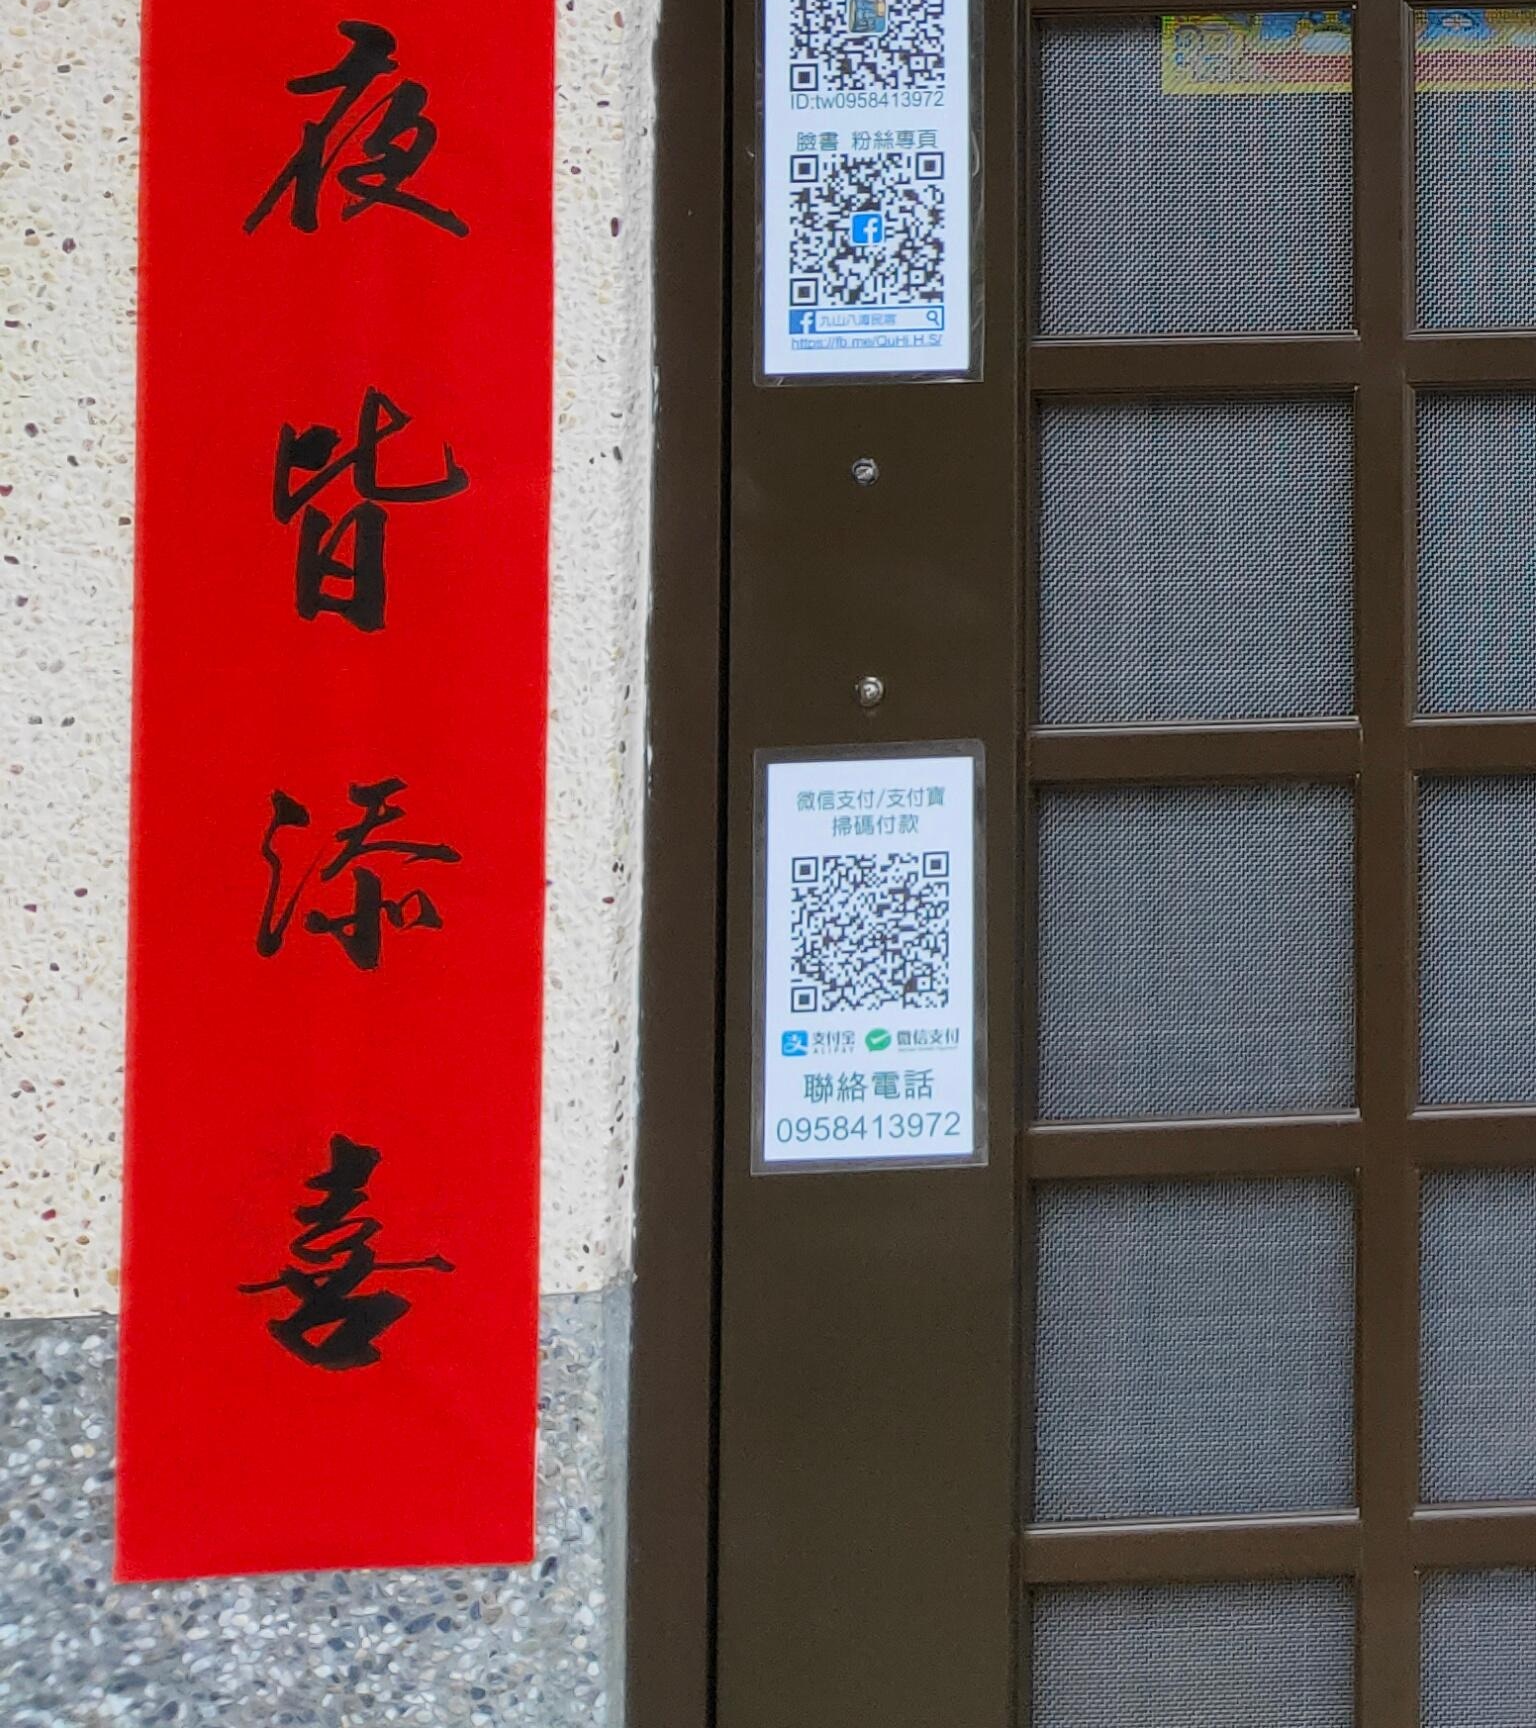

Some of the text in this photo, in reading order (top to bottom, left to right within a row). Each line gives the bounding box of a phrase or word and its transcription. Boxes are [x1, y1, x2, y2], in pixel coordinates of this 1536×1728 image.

[790, 91, 944, 110] ID:tw0958413972
[797, 129, 938, 151] 臉書 粉絲專頁
[797, 786, 946, 812] 微信支付/支付寶
[832, 814, 919, 837] 掃碼付款
[804, 1069, 935, 1104] 聯絡電話
[776, 1111, 961, 1143] 0958413972
